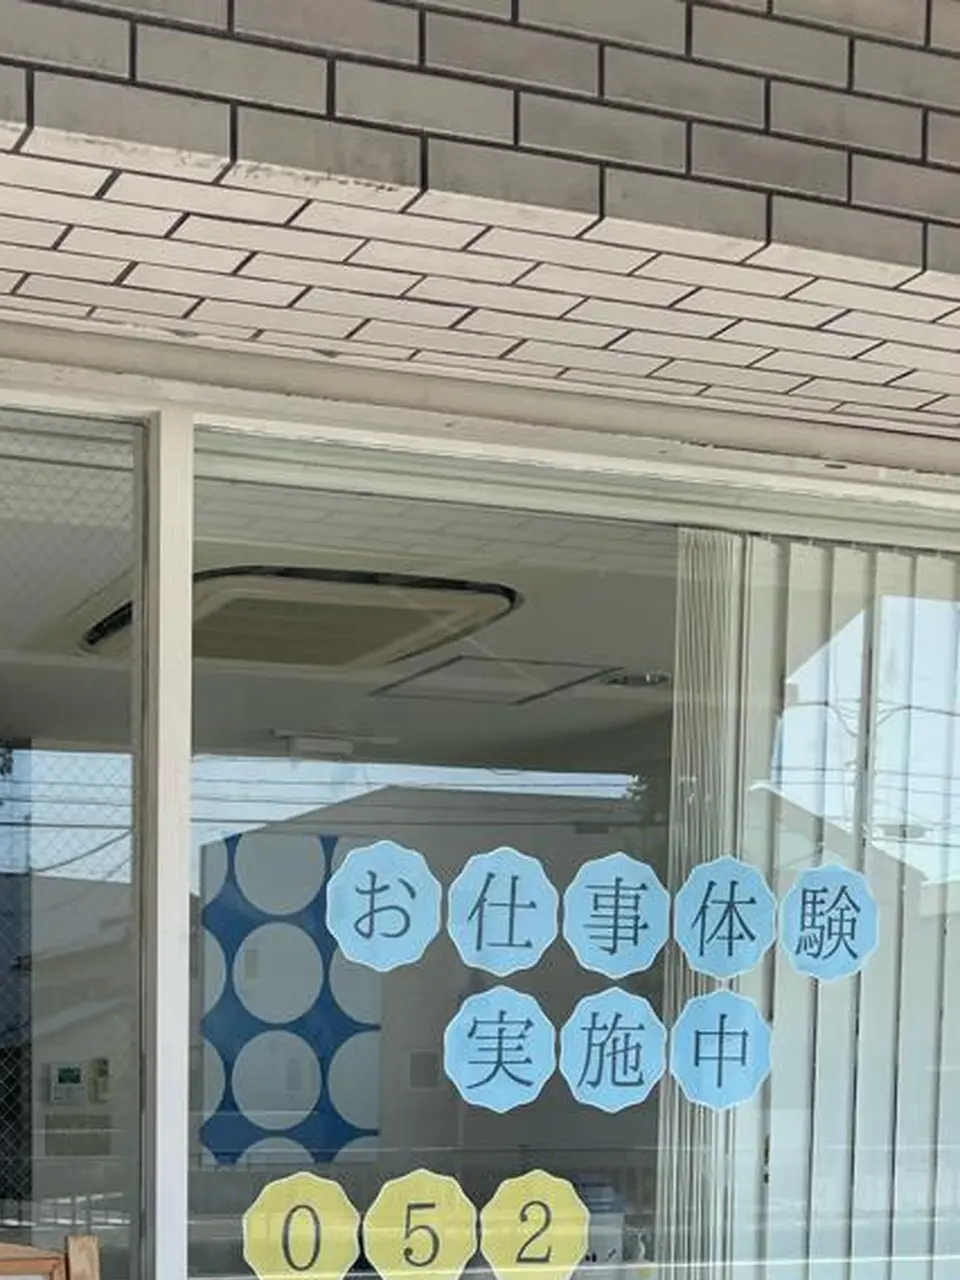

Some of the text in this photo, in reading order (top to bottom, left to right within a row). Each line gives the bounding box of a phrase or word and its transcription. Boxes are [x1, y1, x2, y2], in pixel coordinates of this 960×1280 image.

[353, 869, 861, 962] お仕事体験
[465, 1009, 749, 1090] 実施中
[282, 1200, 553, 1272] 052
